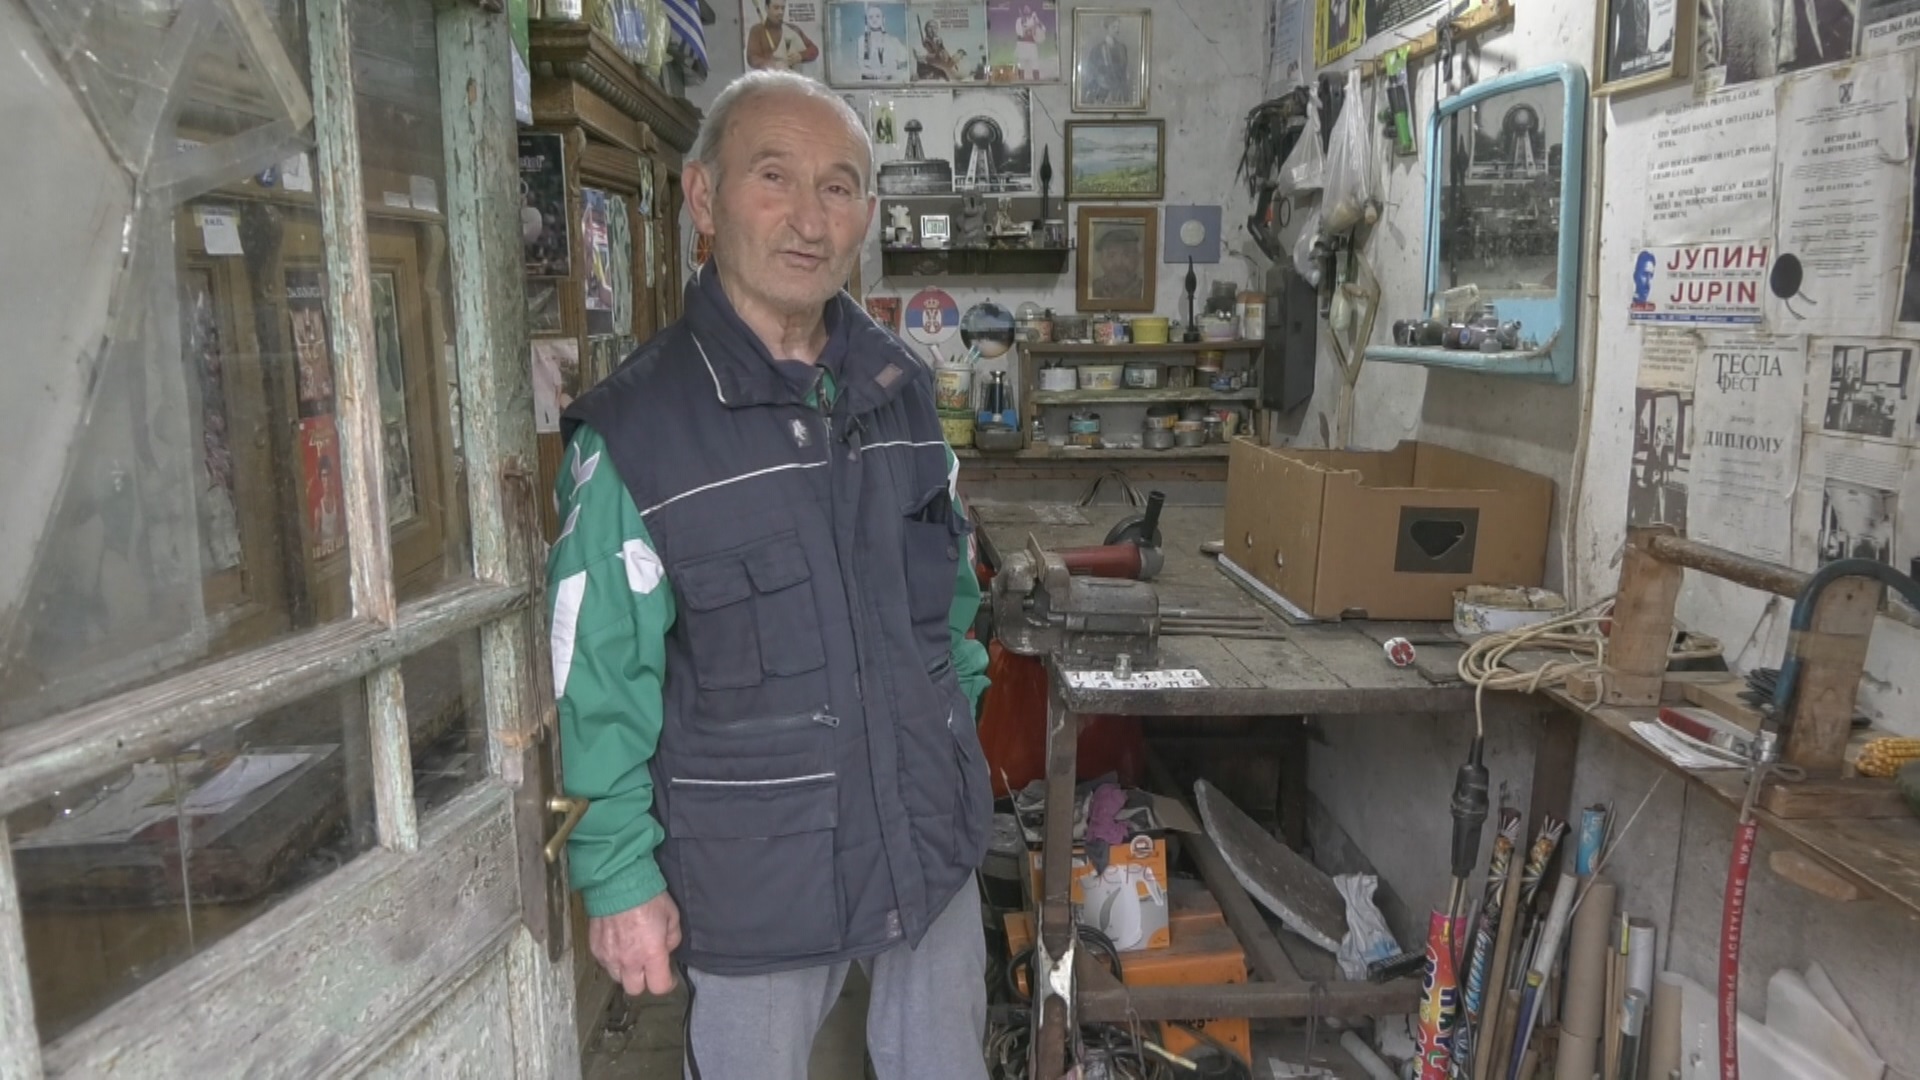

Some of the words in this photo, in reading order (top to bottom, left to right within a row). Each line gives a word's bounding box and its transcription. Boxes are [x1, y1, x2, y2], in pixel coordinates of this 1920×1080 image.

[1667, 246, 1767, 270] ЈУПИН
[1670, 281, 1756, 303] JUPIN
[1713, 353, 1783, 384] ТЕСЛА
[1719, 373, 1760, 394] ФЕСТ
[1703, 430, 1784, 453] ДИПЛОМУ
[1727, 878, 1745, 960] ACETYLENE
